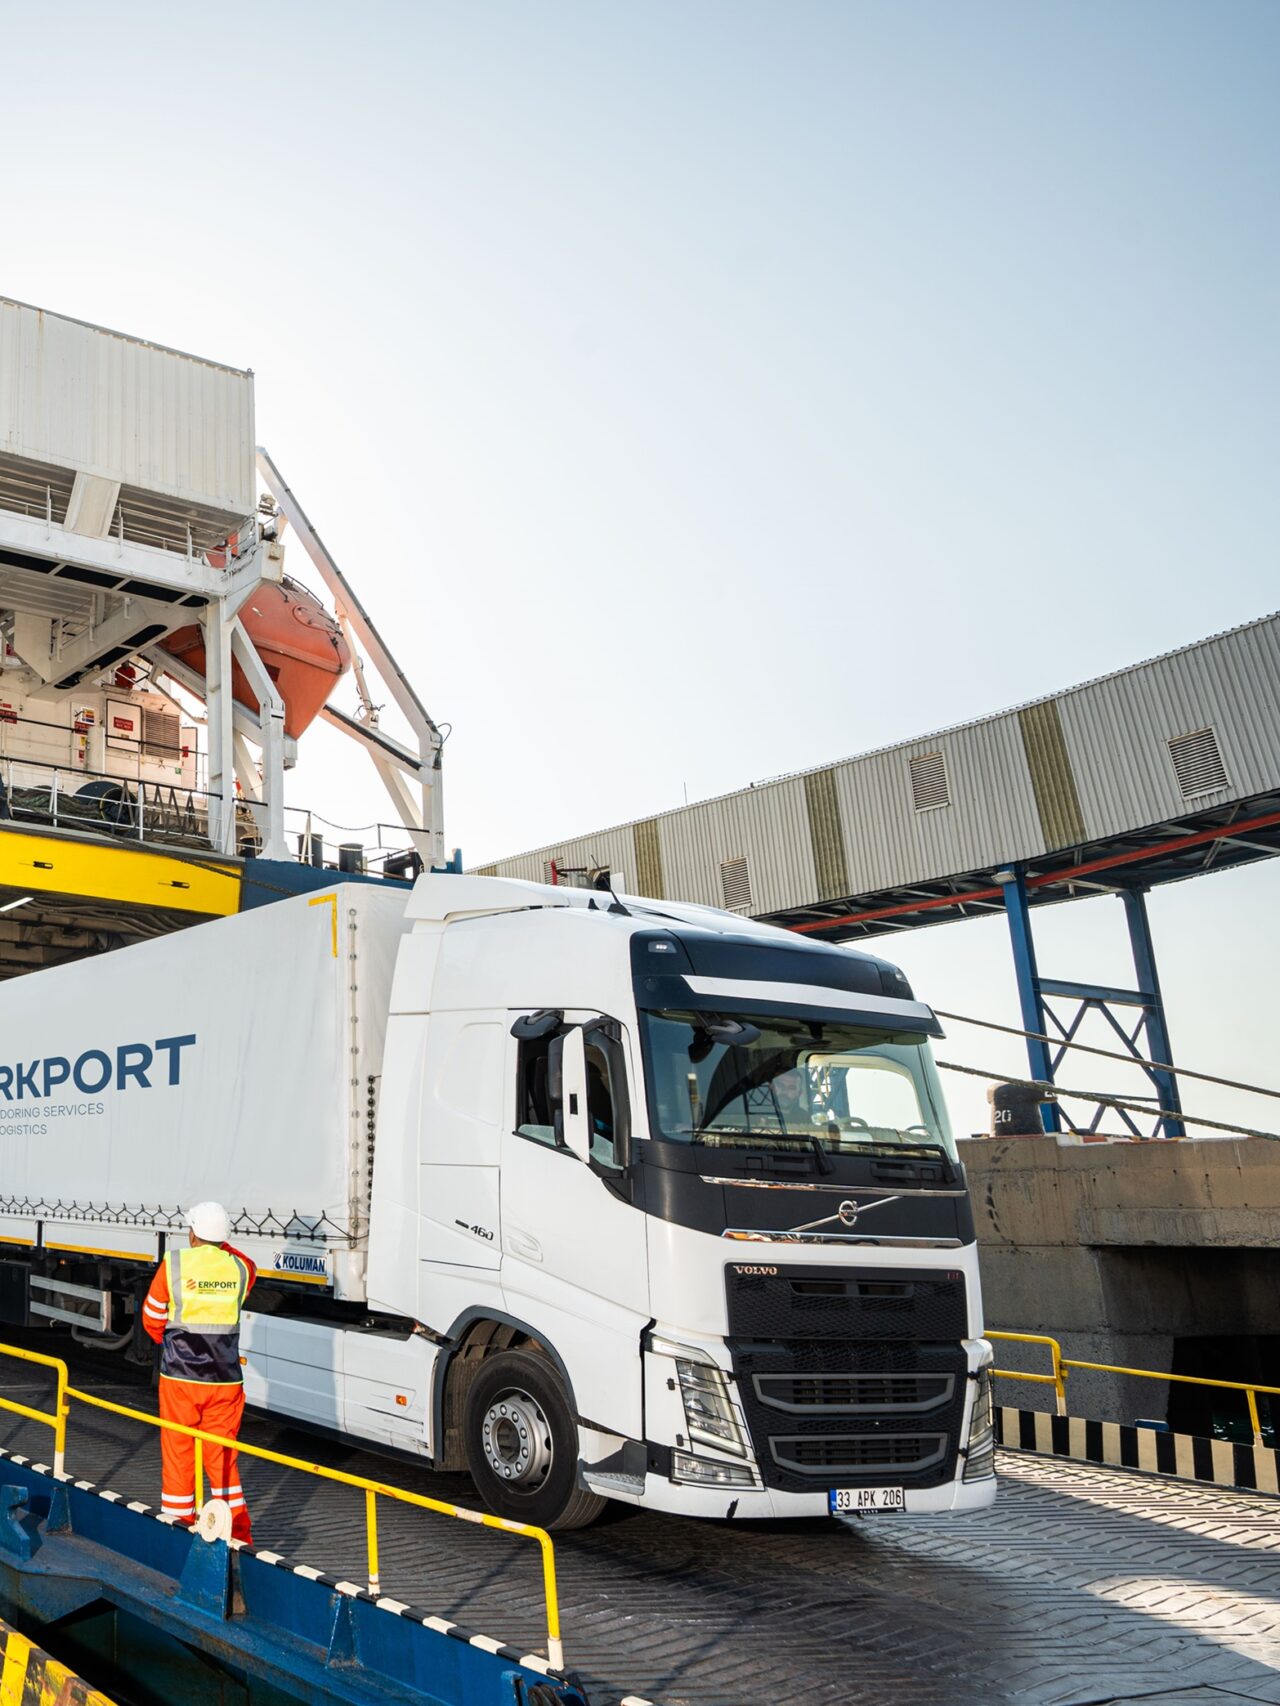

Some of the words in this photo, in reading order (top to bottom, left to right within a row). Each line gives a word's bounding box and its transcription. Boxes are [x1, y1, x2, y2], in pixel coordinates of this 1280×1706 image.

[43, 1102, 105, 1117] SERVICES
[470, 1225, 494, 1241] 460
[282, 1255, 326, 1273] KOLUMAN
[732, 1265, 778, 1275] VOLVO
[198, 1281, 237, 1289] ERKPORT
[837, 1491, 851, 1508] 33
[857, 1489, 877, 1507] APK
[882, 1488, 902, 1506] 206
